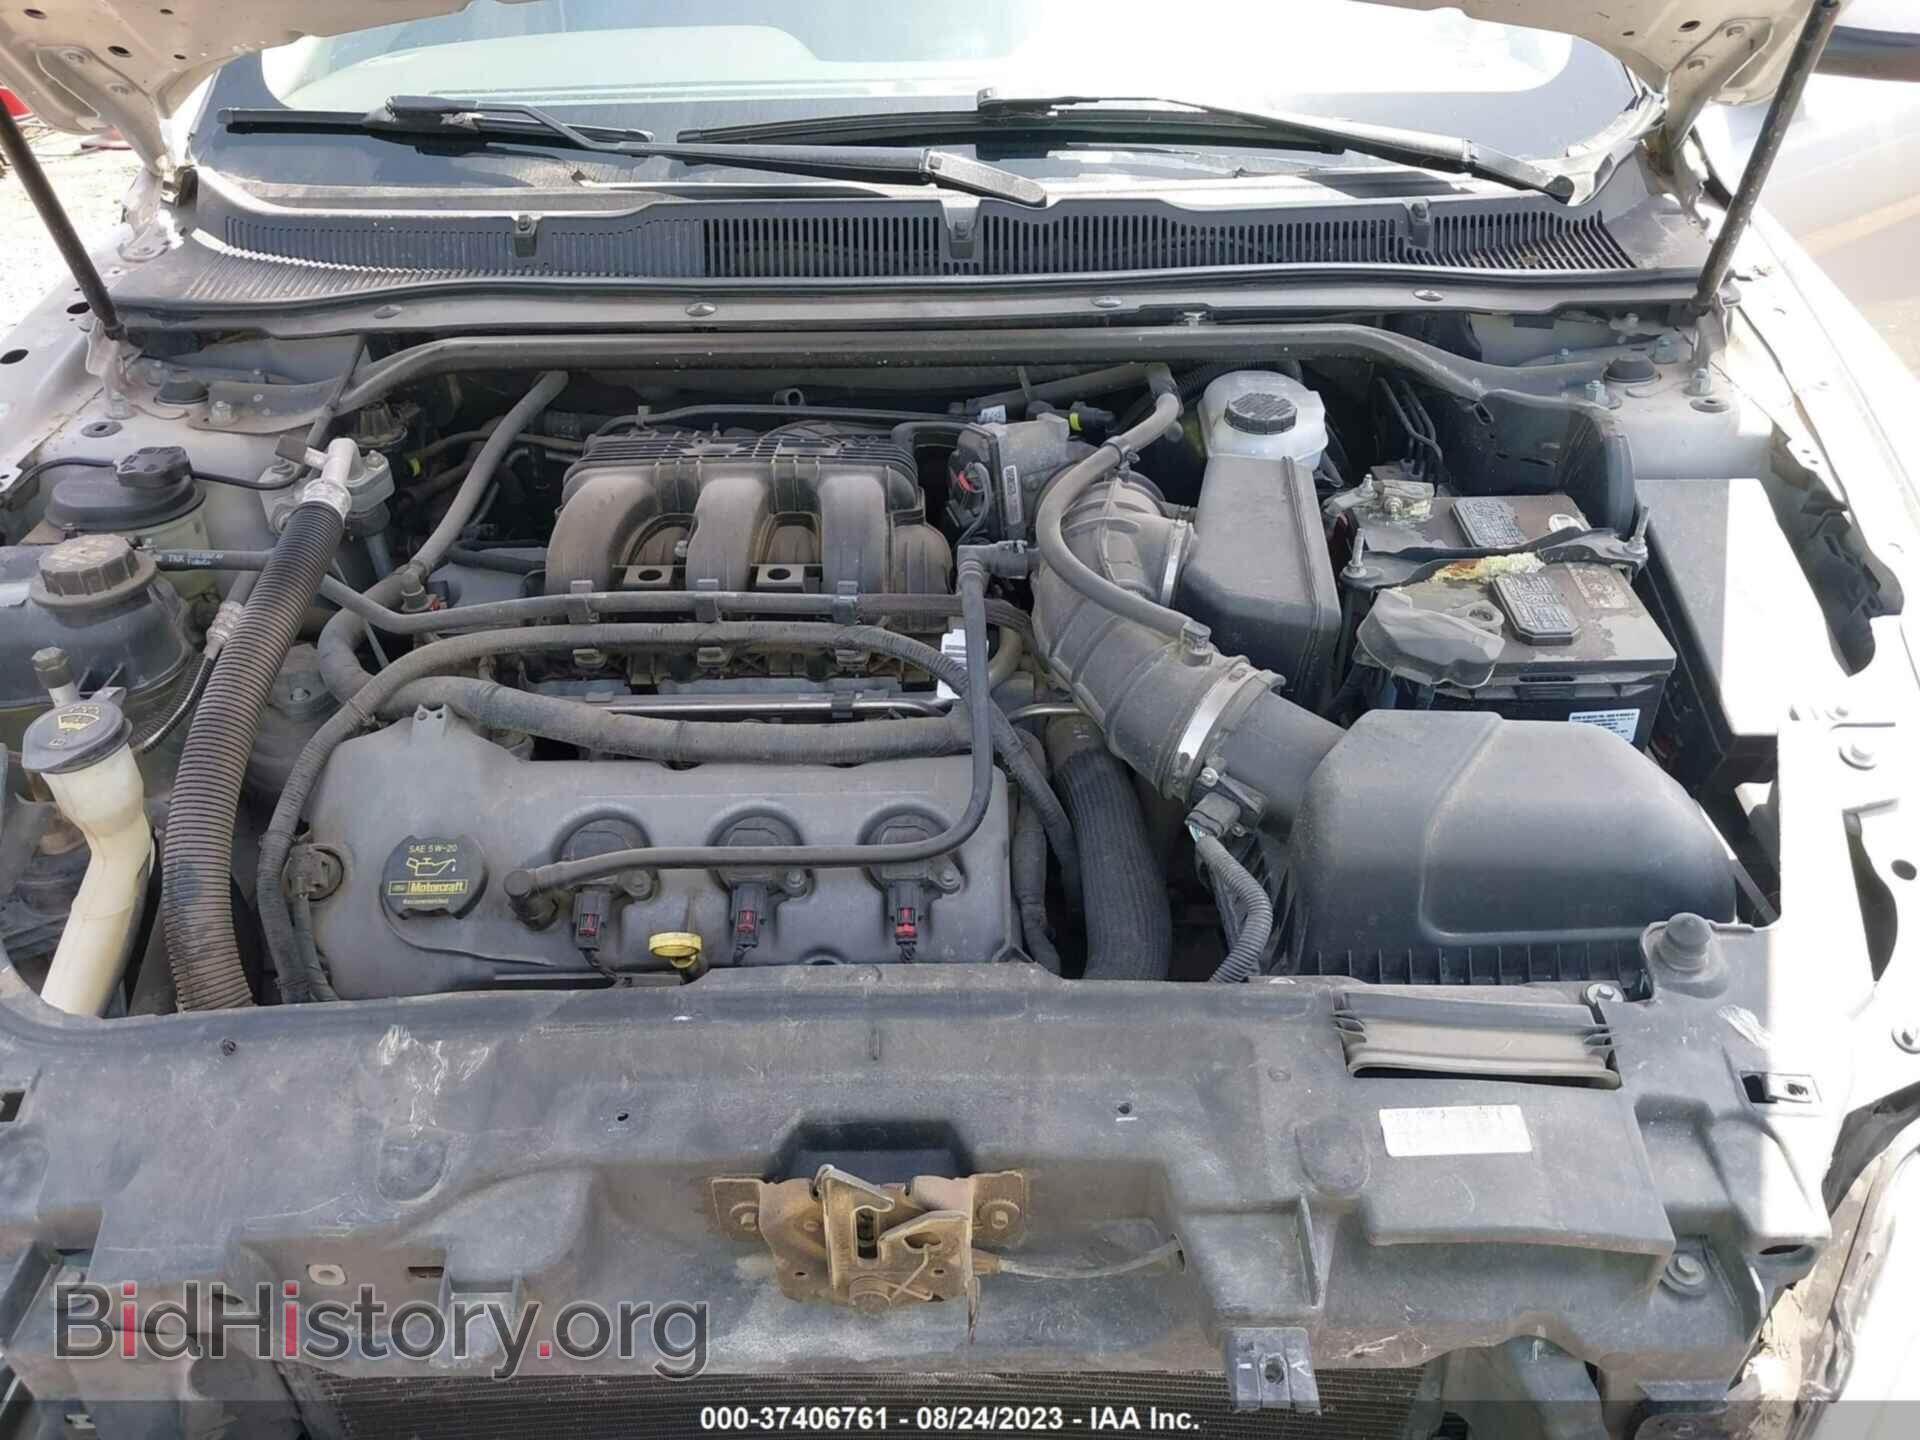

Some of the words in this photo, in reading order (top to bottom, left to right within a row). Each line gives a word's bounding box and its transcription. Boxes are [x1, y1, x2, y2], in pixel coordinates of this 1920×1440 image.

[408, 844, 426, 854] SAE
[428, 843, 458, 853] 5W-20
[410, 881, 464, 893] Motorcraft
